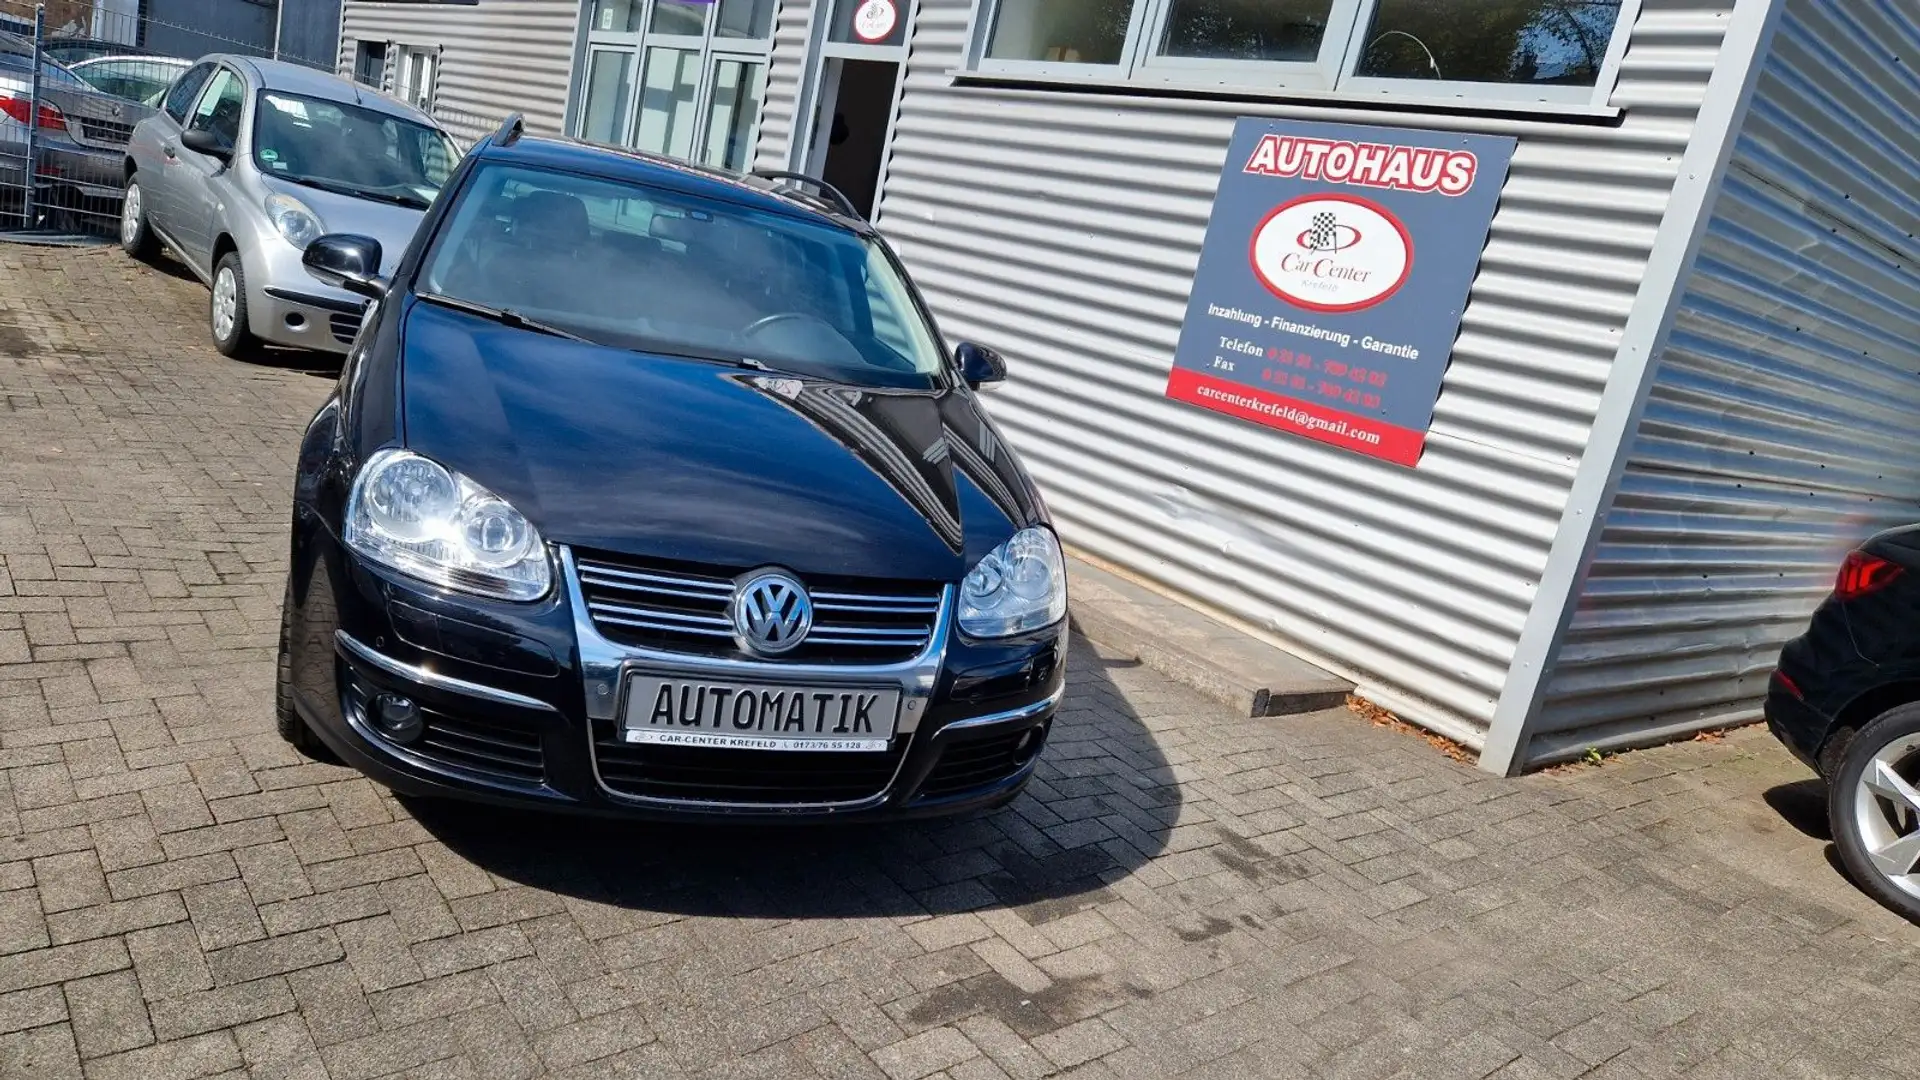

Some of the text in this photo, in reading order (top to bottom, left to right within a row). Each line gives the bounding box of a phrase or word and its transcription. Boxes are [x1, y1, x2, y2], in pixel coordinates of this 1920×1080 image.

[1244, 134, 1477, 196] AUTOHAUS
[1208, 302, 1262, 328] Inzahlung
[1270, 316, 1350, 347] Finanzierung
[1361, 335, 1420, 360] Garantie
[1219, 336, 1264, 358] Telefon
[1214, 355, 1235, 371] Fax
[1196, 385, 1381, 446] carcenterkrefeld@gmail.com
[650, 683, 880, 734] AUTOMATIK
[659, 734, 727, 746] CAR-CENTER
[729, 738, 777, 748] KREFELD
[845, 742, 862, 750] 128
